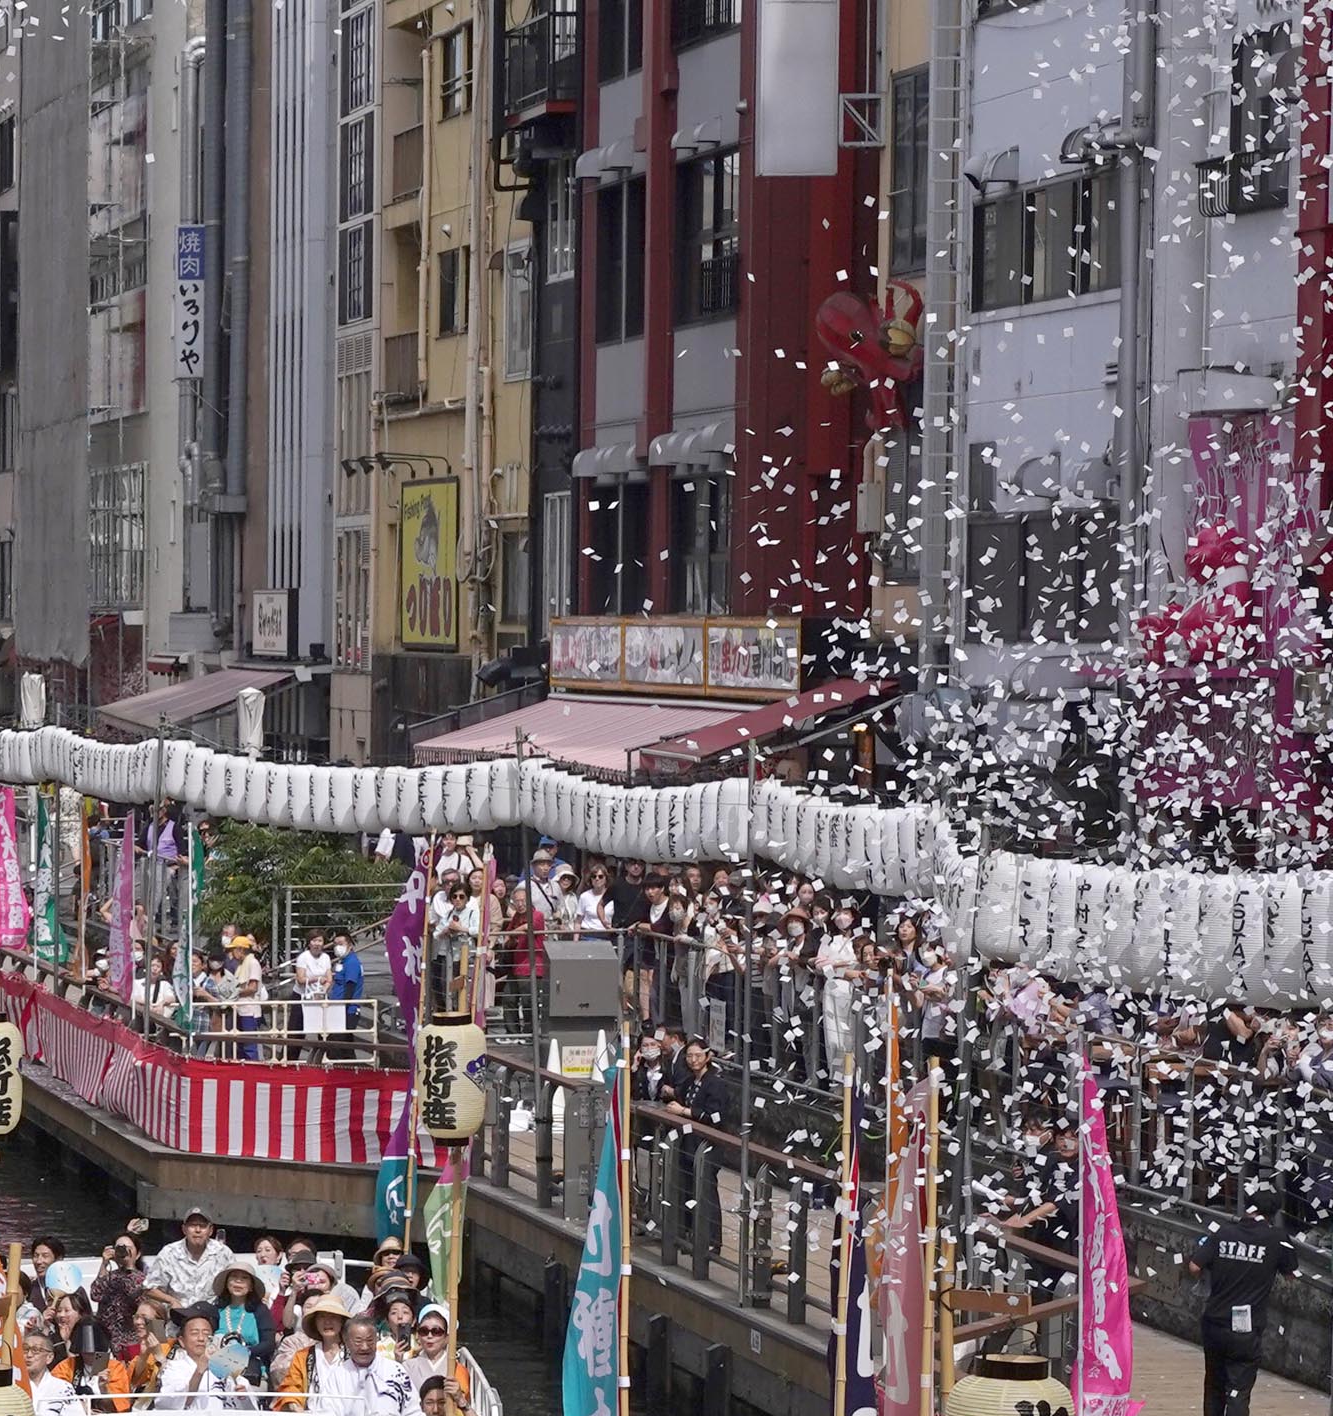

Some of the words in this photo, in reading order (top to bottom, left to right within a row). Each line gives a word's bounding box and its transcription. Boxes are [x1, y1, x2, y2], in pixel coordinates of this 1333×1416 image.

[179, 231, 201, 277] 焼肉
[179, 283, 200, 374] いろりや
[1219, 1241, 1266, 1259] STAFF
